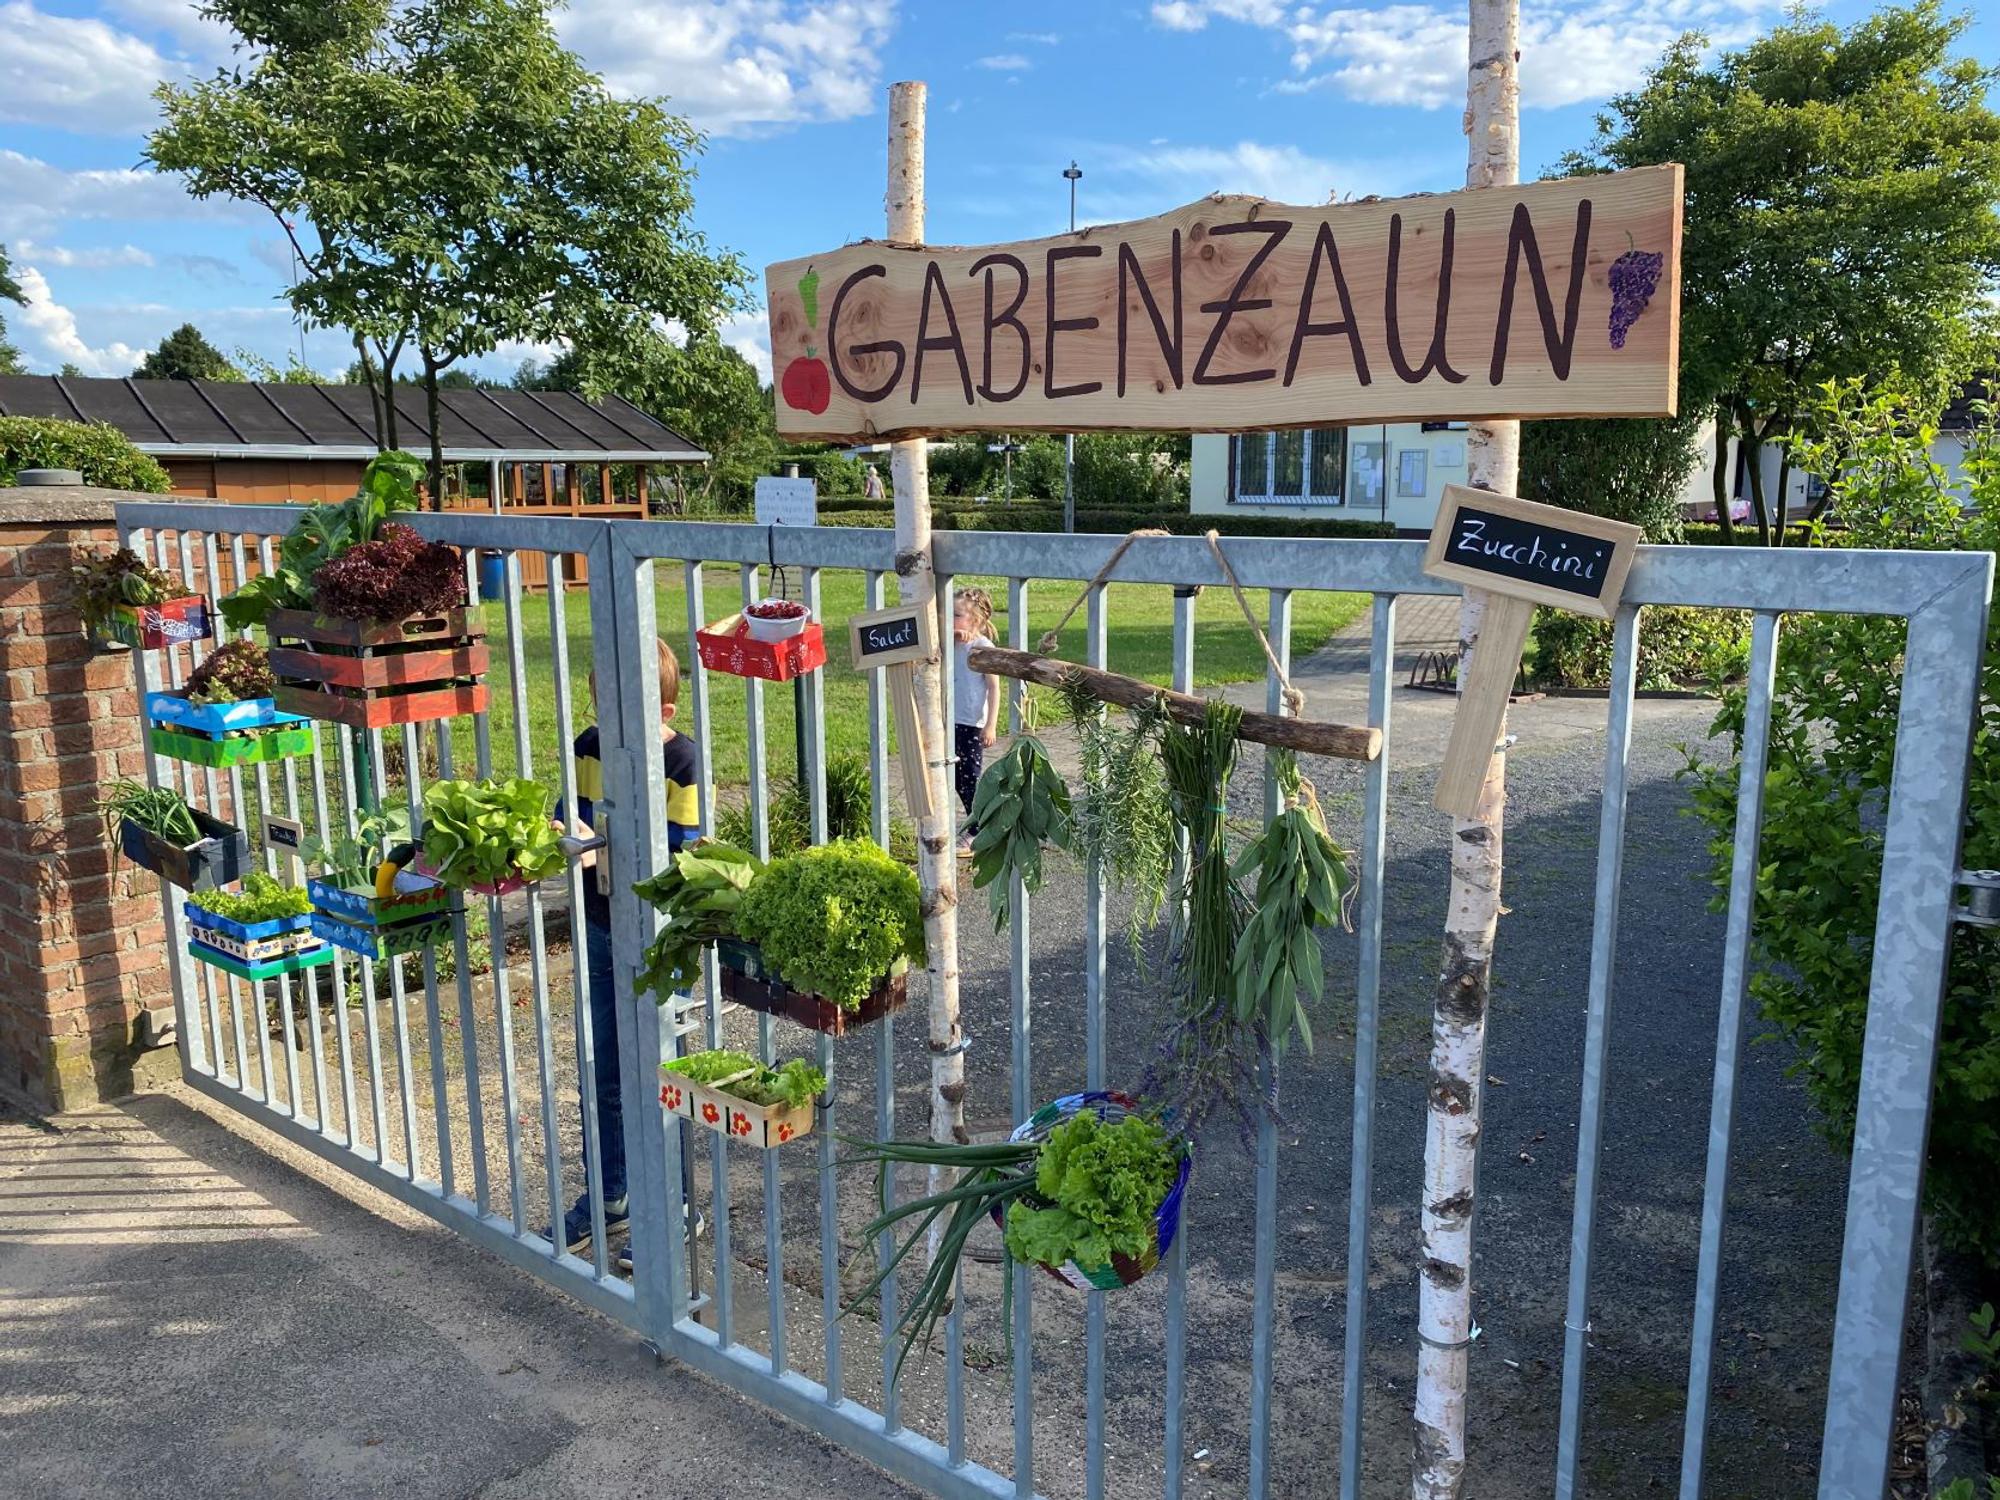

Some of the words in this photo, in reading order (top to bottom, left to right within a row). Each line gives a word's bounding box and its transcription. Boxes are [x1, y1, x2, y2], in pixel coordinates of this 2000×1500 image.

[828, 199, 1593, 404] GABENZAUN
[1458, 519, 1602, 578] Zucchini
[869, 621, 912, 649] Salat
